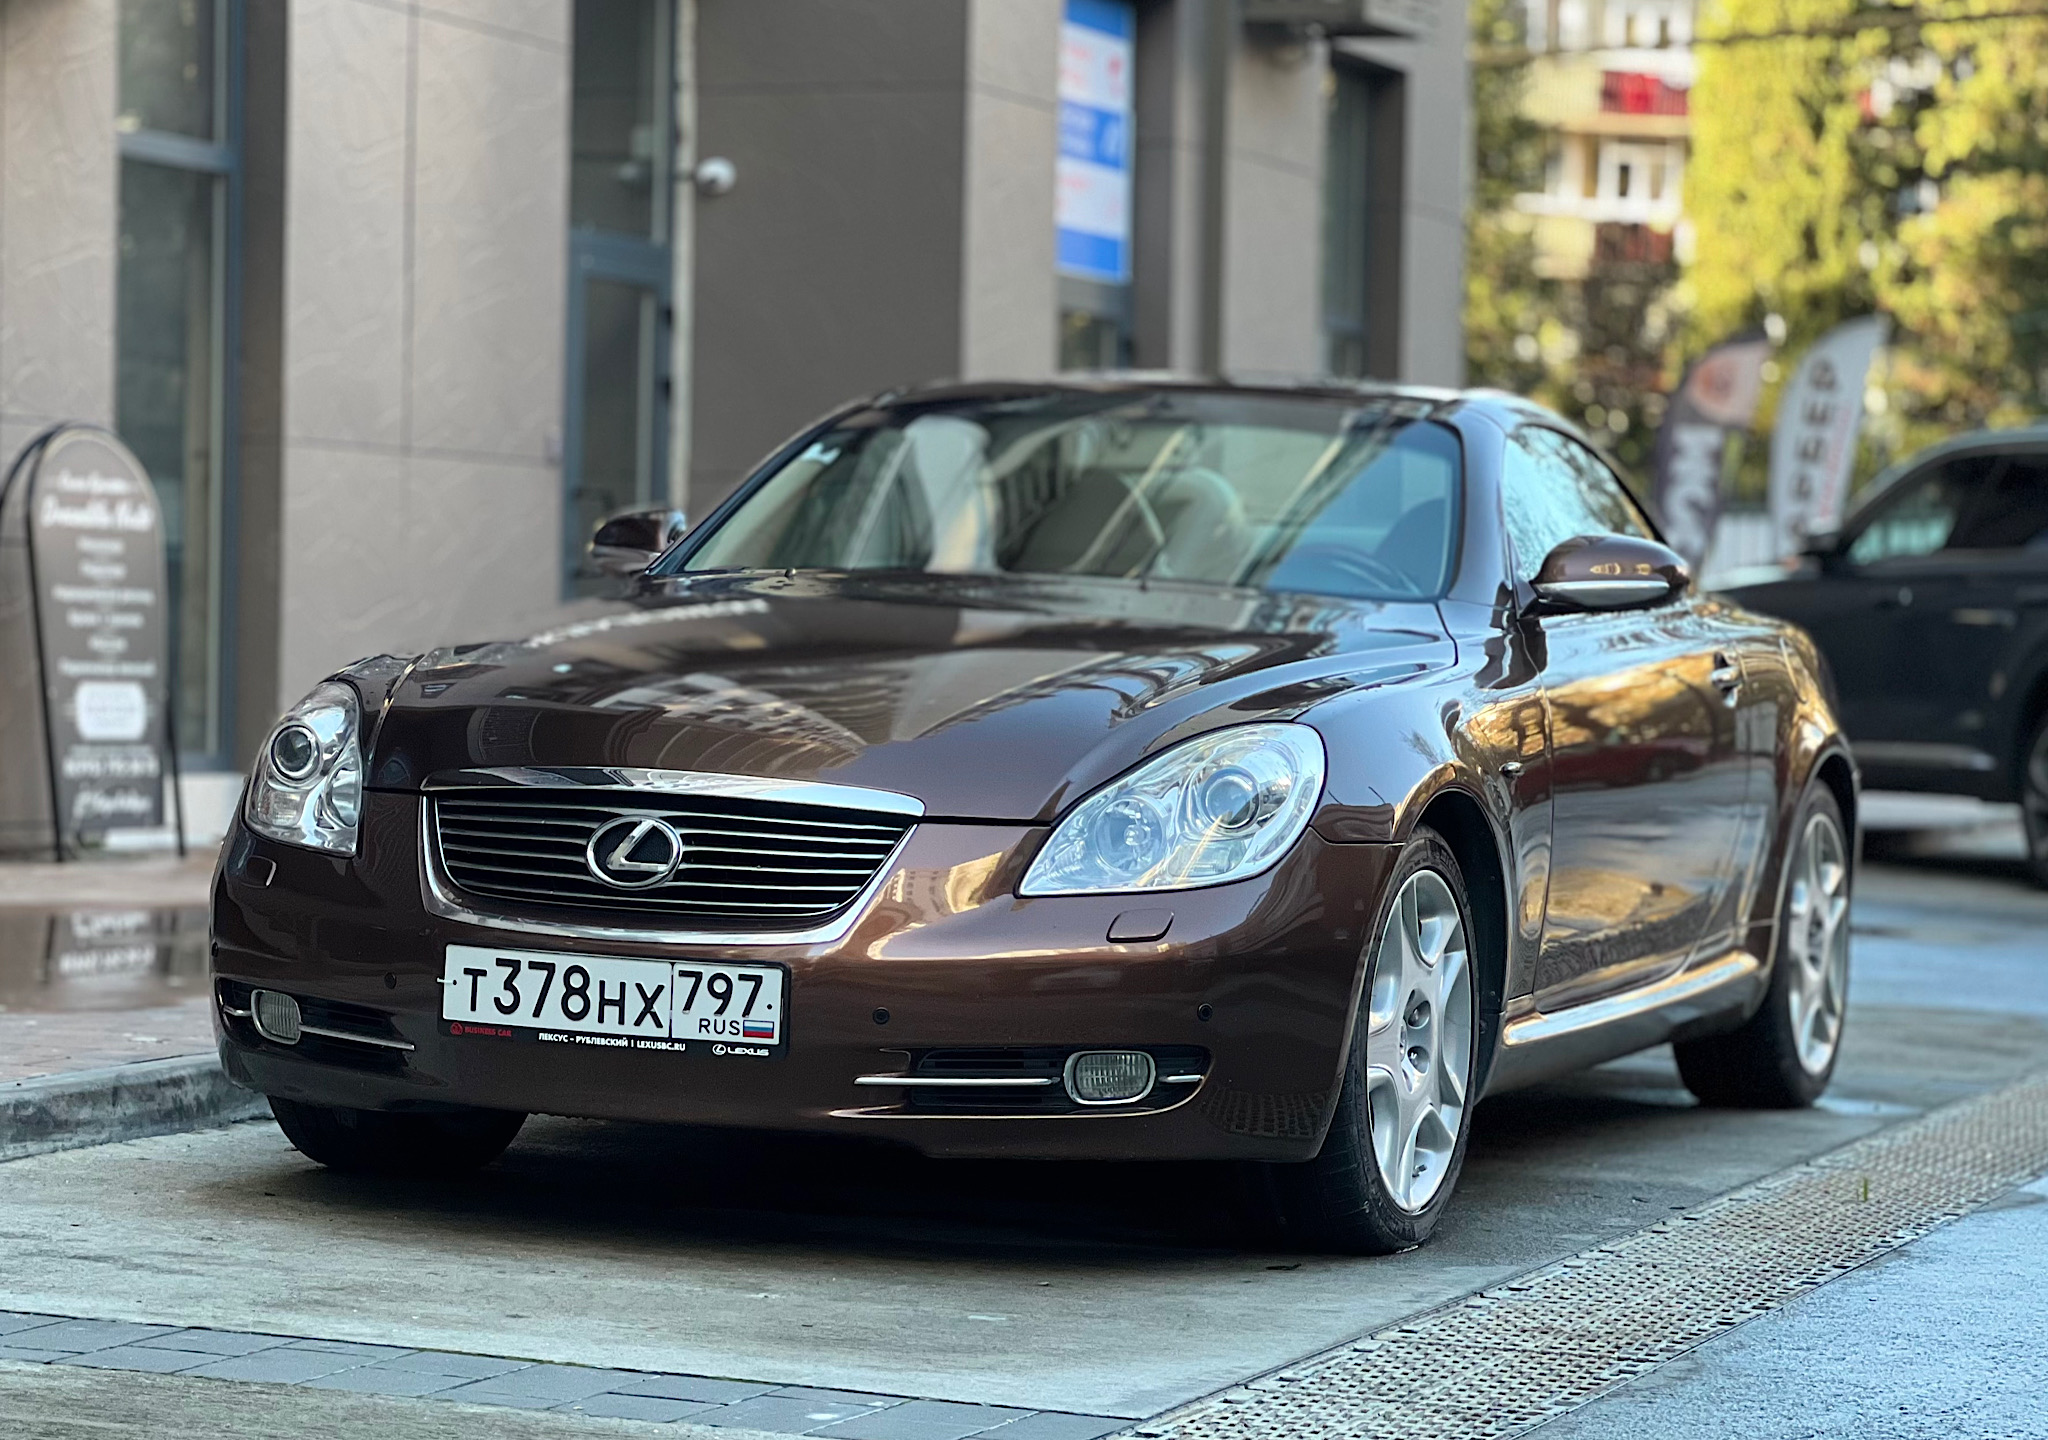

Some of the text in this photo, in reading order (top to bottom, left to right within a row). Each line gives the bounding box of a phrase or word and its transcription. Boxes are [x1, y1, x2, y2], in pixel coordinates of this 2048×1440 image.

[678, 970, 764, 1018] 797
[464, 1026, 512, 1037] BUSINESS CAR
[698, 1018, 741, 1037] RUS
[538, 1032, 569, 1043] ЛЕКСУС
[575, 1035, 629, 1048] РУБЛЕВСКИЙ
[636, 1040, 686, 1051] LEXUSBC.RU
[727, 1046, 770, 1057] LEXUS
